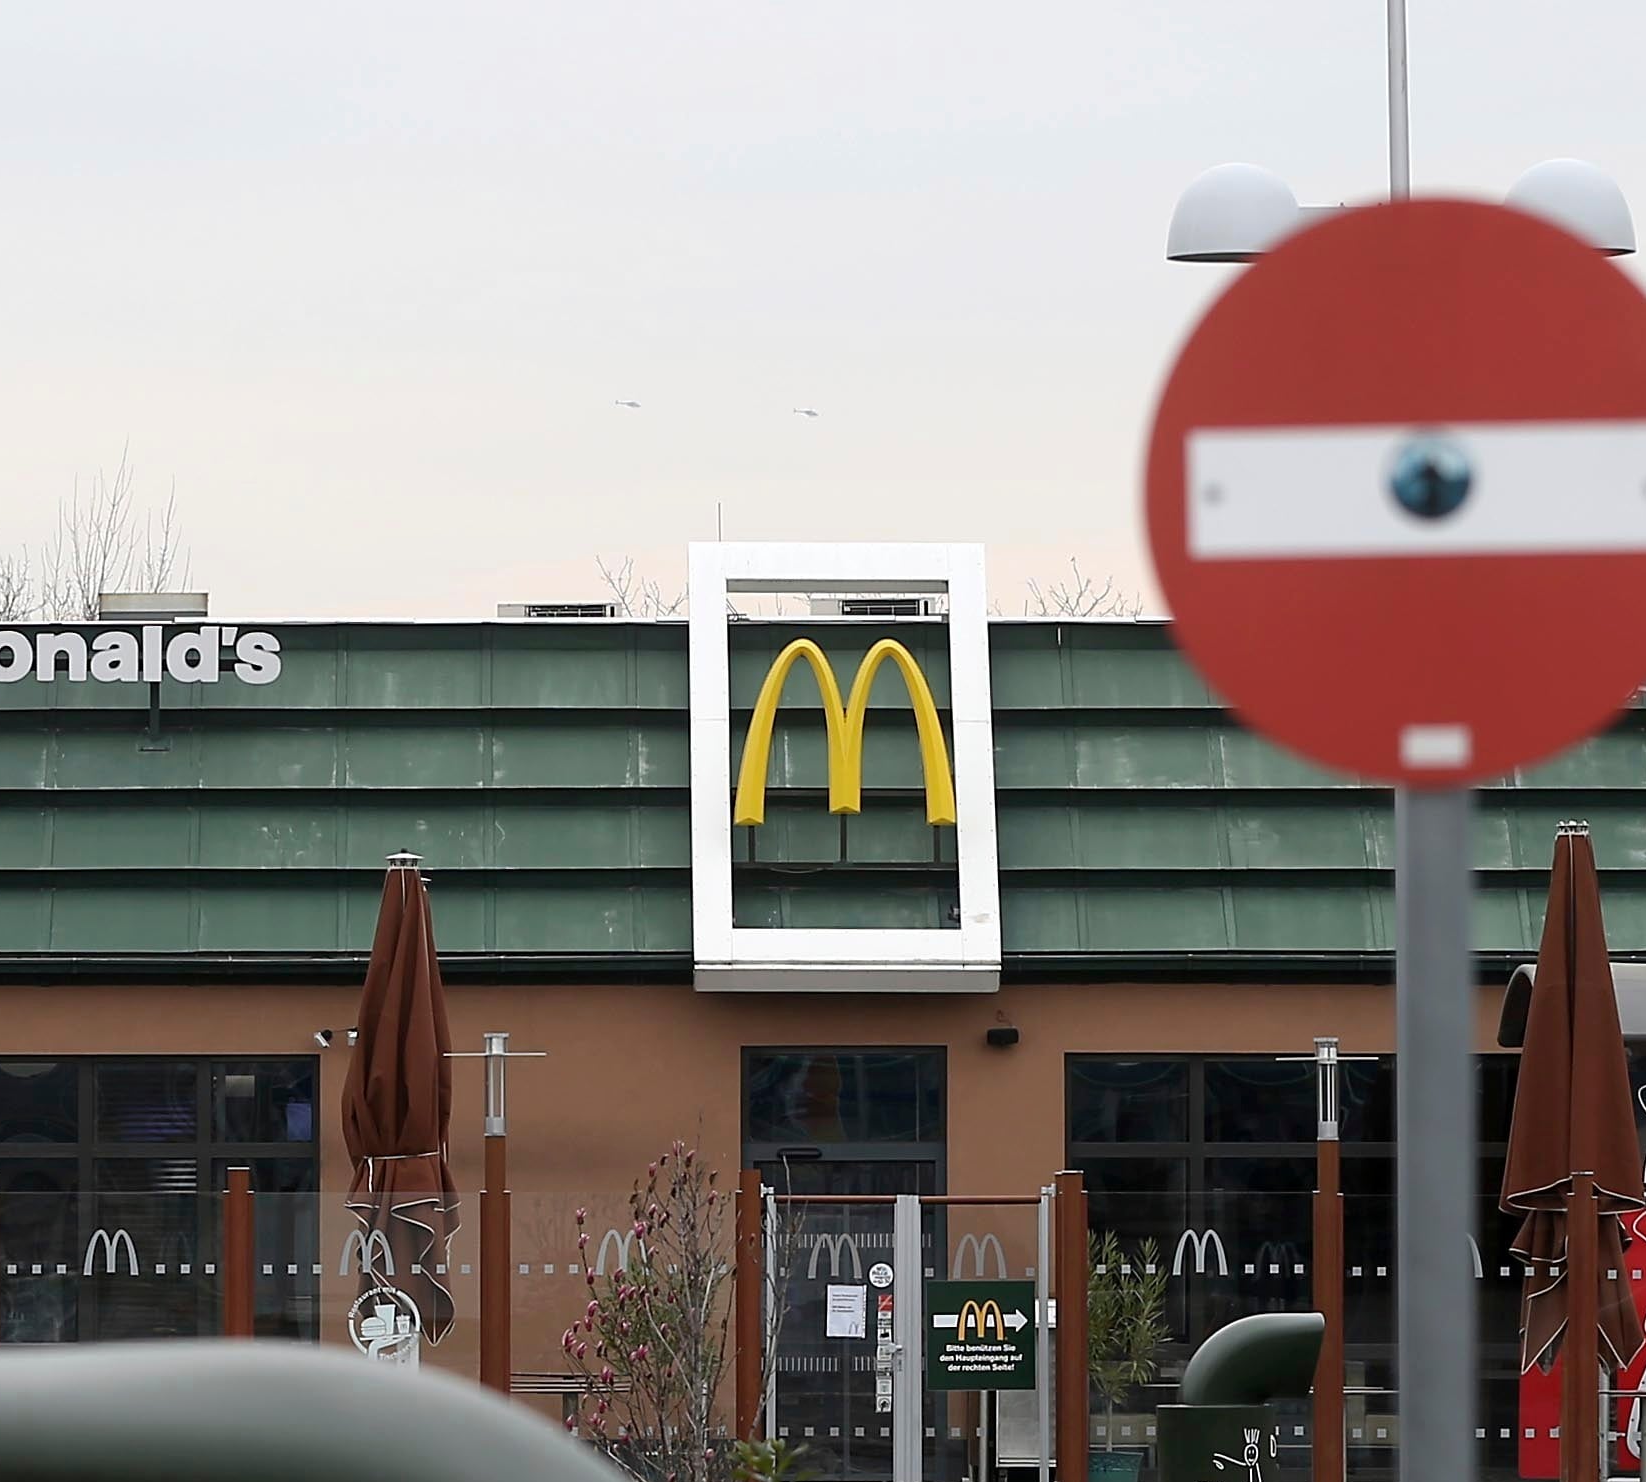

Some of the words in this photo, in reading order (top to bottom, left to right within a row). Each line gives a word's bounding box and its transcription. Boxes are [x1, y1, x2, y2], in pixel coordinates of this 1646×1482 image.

[946, 1344, 965, 1352] Bitte
[1003, 1344, 1016, 1352] Sie
[939, 1354, 955, 1362] den
[955, 1354, 1009, 1363] Haupteingang
[1010, 1353, 1023, 1361] auf
